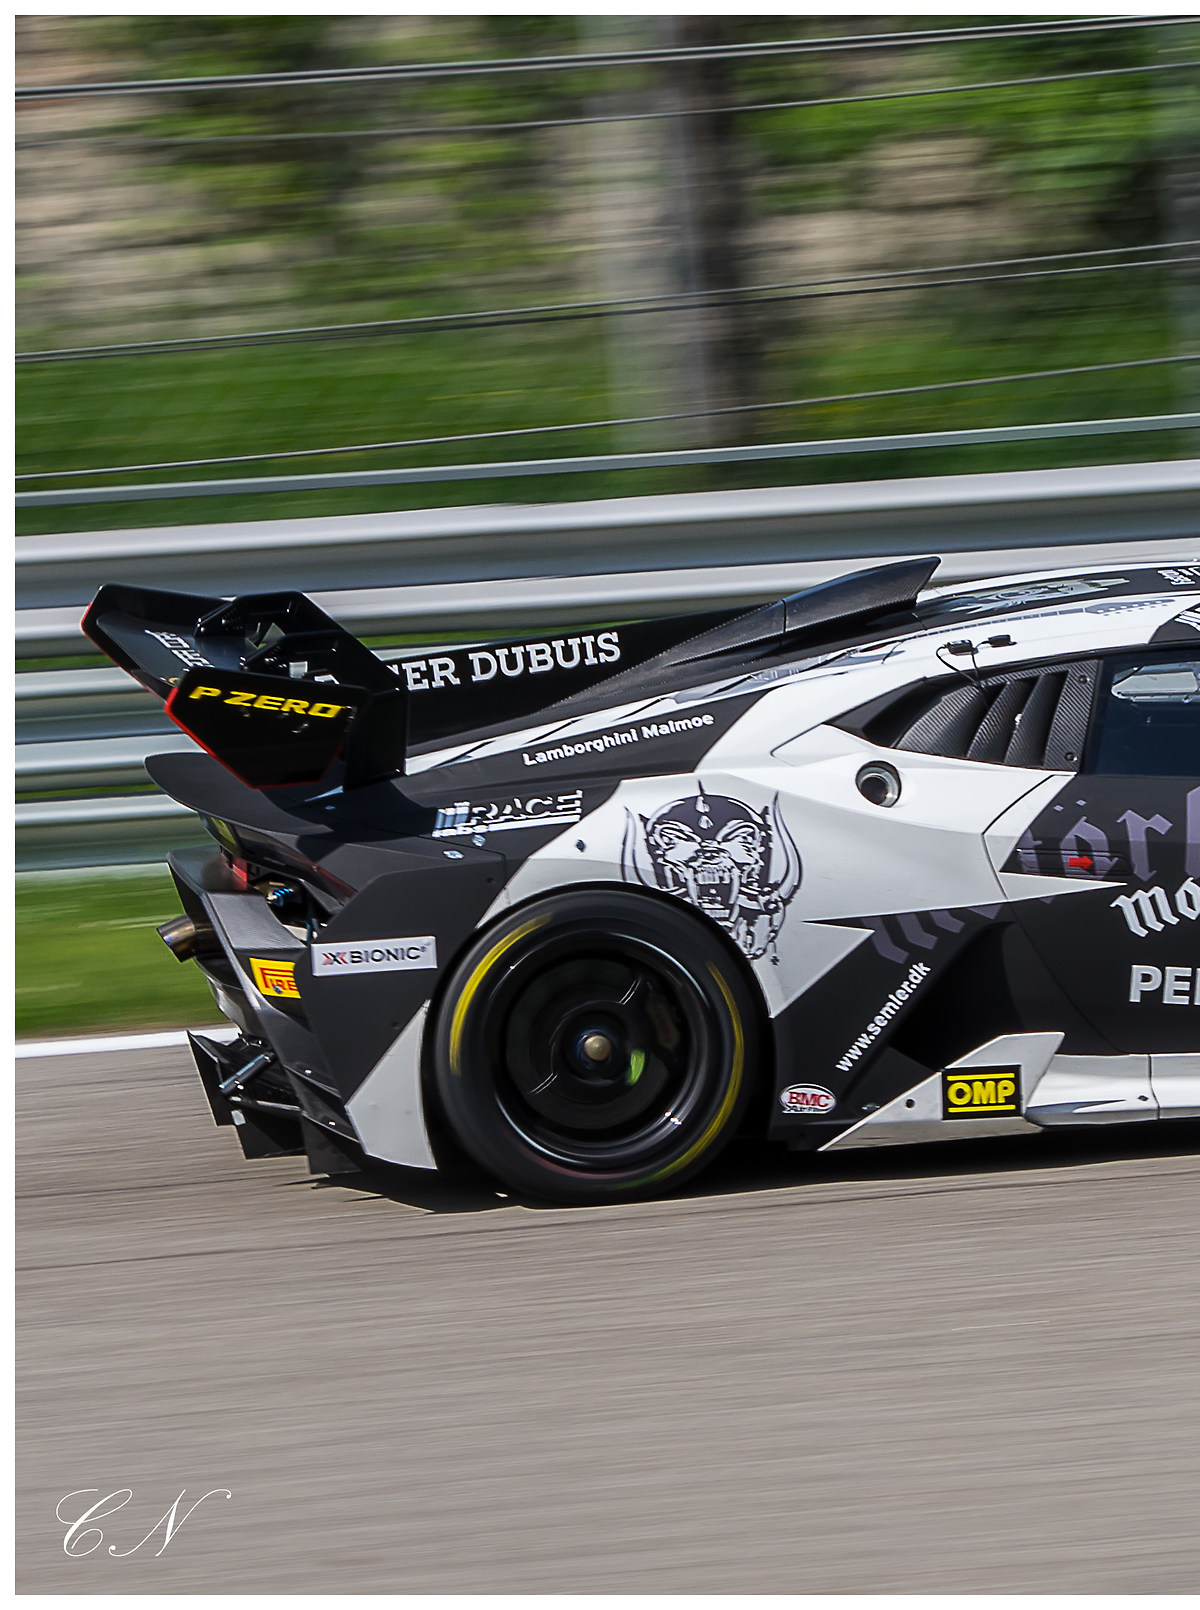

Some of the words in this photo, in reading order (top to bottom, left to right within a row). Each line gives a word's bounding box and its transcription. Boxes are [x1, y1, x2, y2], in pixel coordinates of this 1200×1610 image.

[468, 632, 621, 683] DUBUIS
[189, 686, 222, 700] P
[224, 691, 344, 719] ZERO
[522, 728, 639, 767] Lamborghini
[642, 713, 715, 739] Malmoe
[835, 961, 931, 1073] www.semler.dk
[787, 1091, 830, 1107] BMC
[947, 1080, 1016, 1105] OMP
